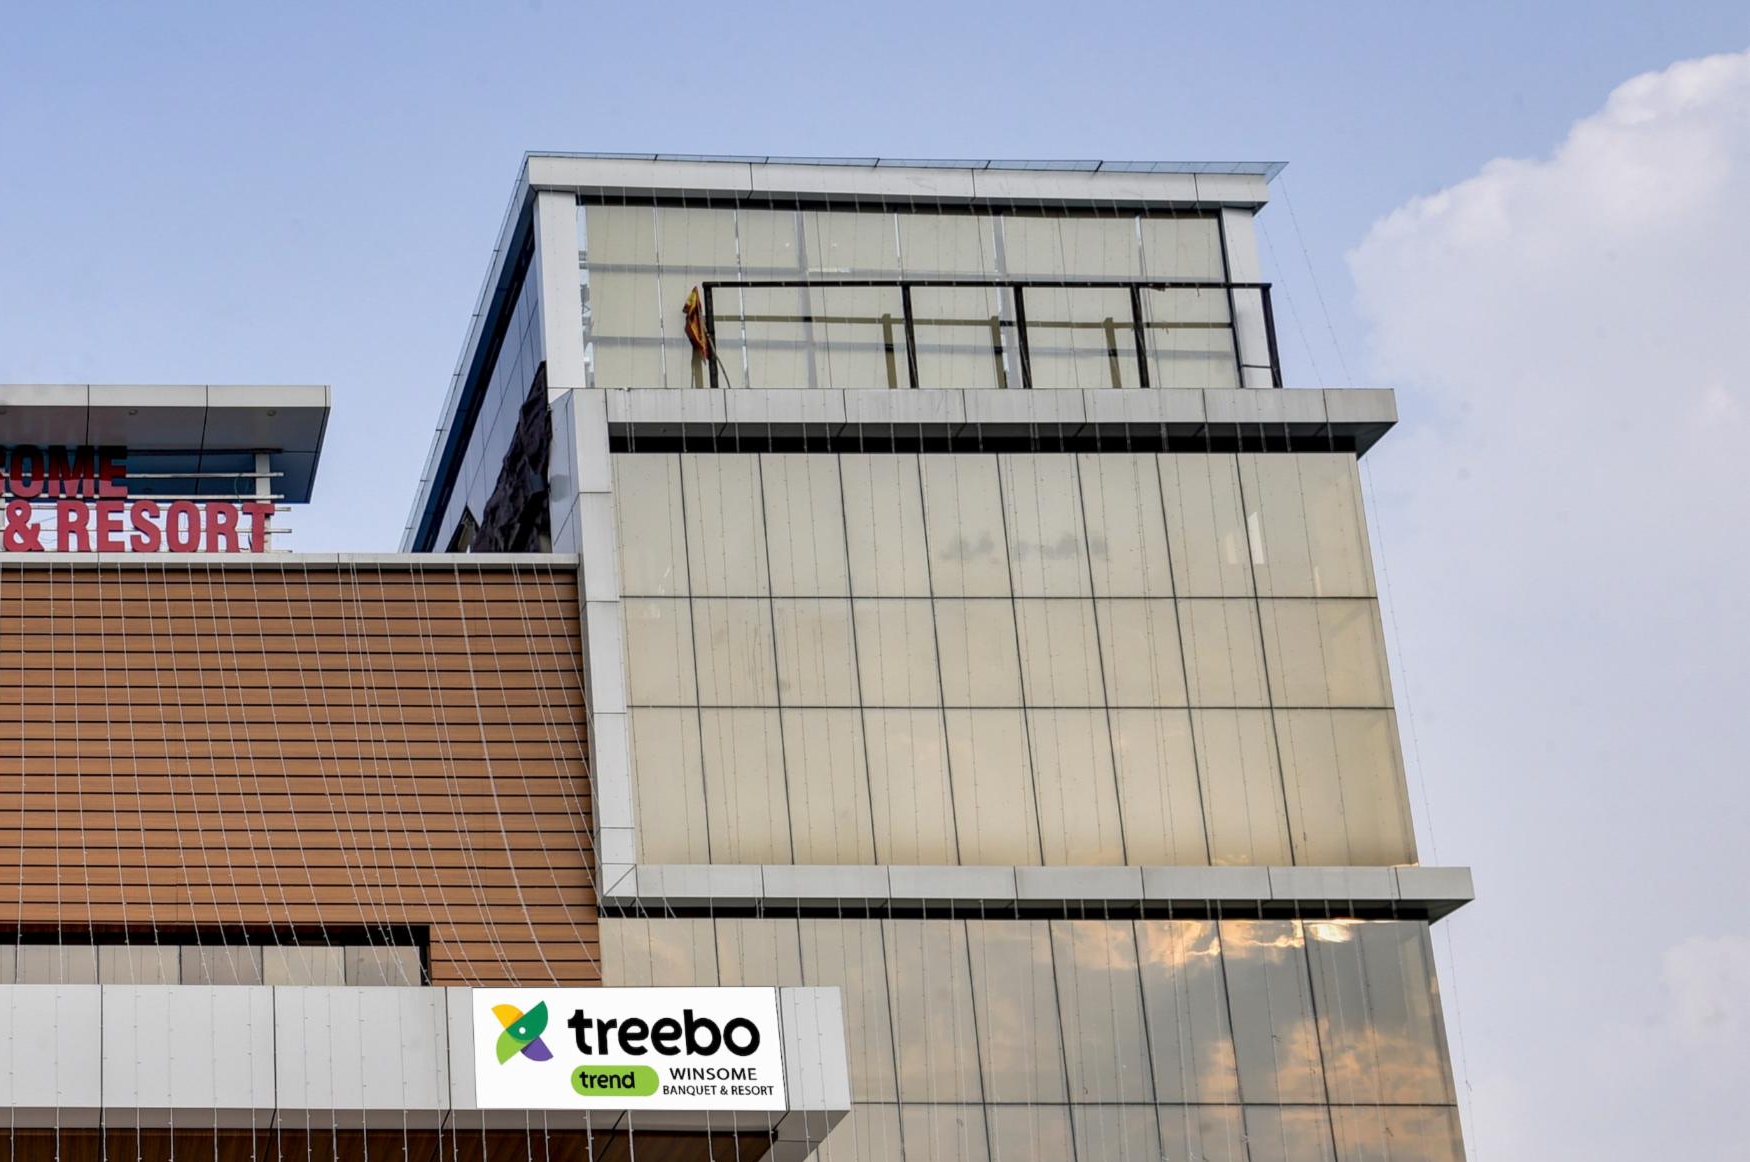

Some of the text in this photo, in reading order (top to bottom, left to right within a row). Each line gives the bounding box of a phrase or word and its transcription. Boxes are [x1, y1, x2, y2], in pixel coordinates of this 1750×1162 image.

[3, 499, 44, 552] &
[56, 499, 274, 553] RESORT
[567, 1009, 761, 1057] treebo
[579, 1071, 636, 1089] trend
[669, 1067, 758, 1081] WINSOME
[662, 1084, 775, 1096] BANQUET & RESORT
